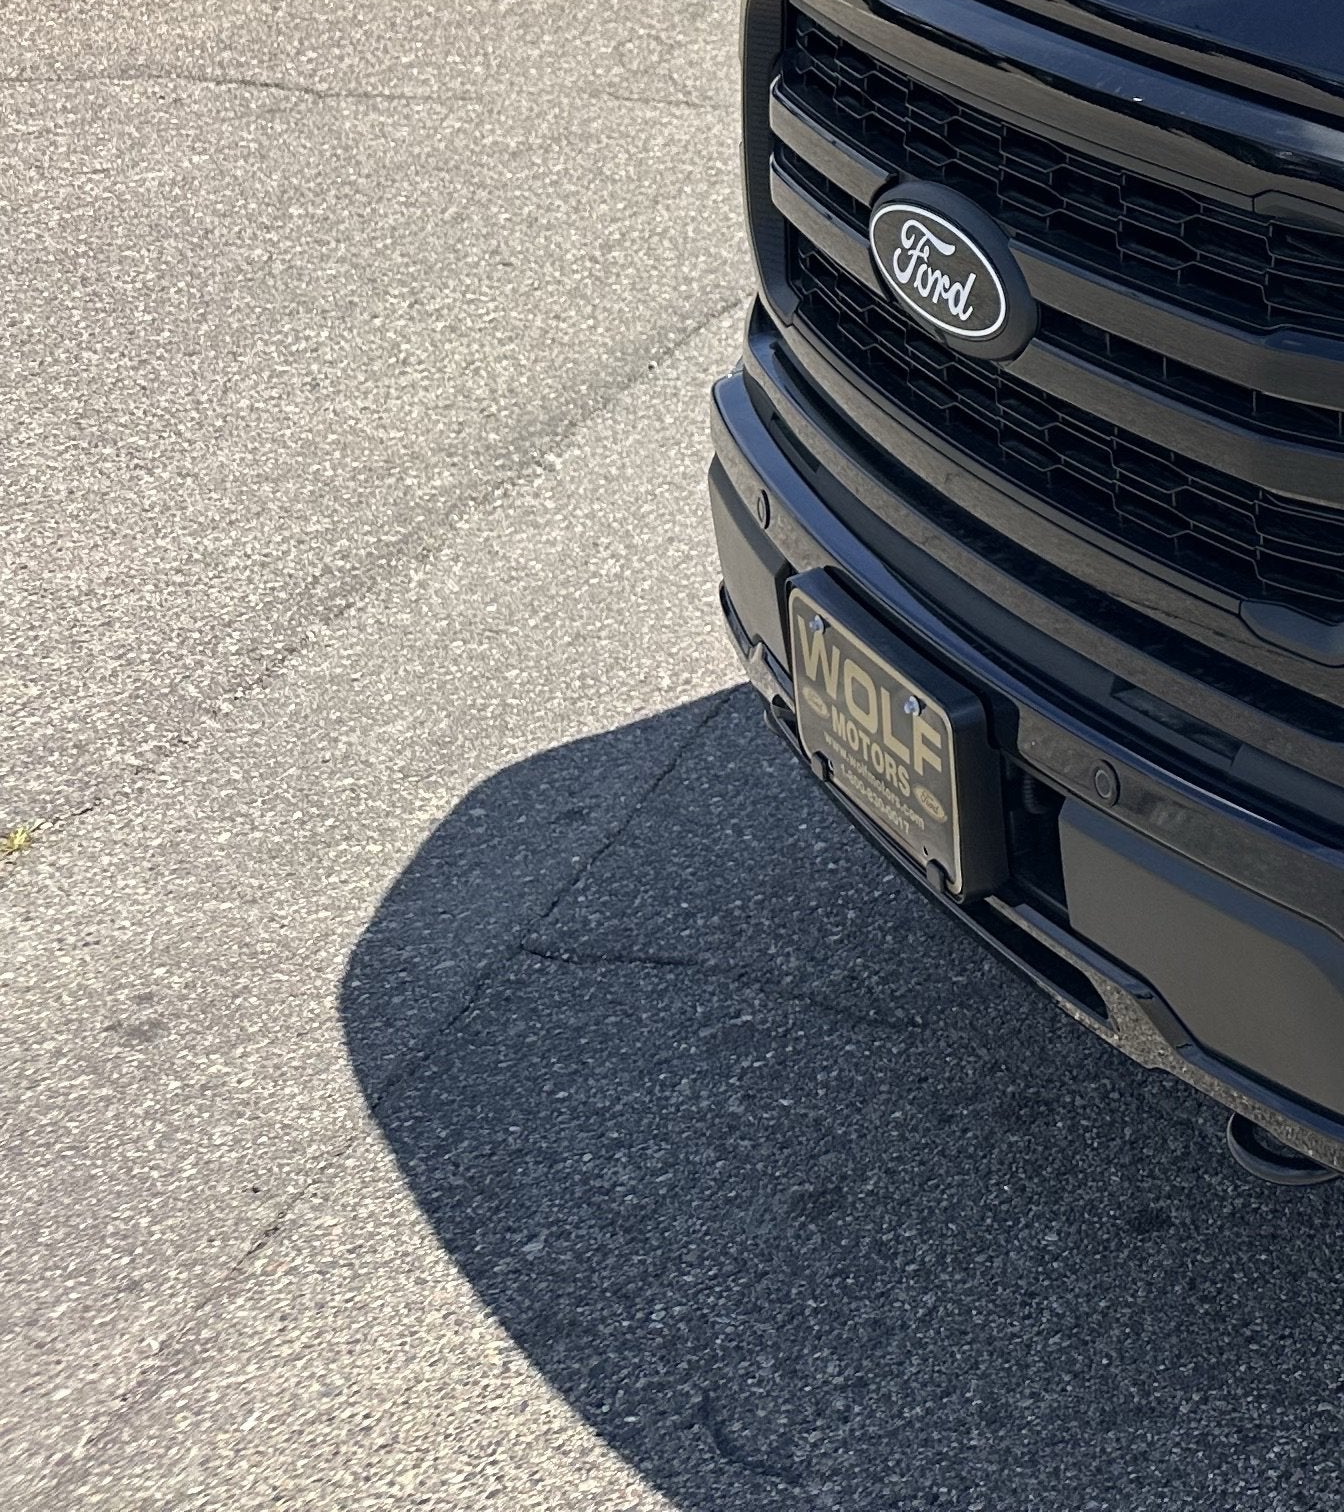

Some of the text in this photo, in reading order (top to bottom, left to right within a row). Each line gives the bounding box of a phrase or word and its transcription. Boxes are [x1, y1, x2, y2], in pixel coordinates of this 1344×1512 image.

[892, 218, 977, 321] Ford
[797, 614, 943, 777] WOLF
[830, 704, 912, 798] MOTORS
